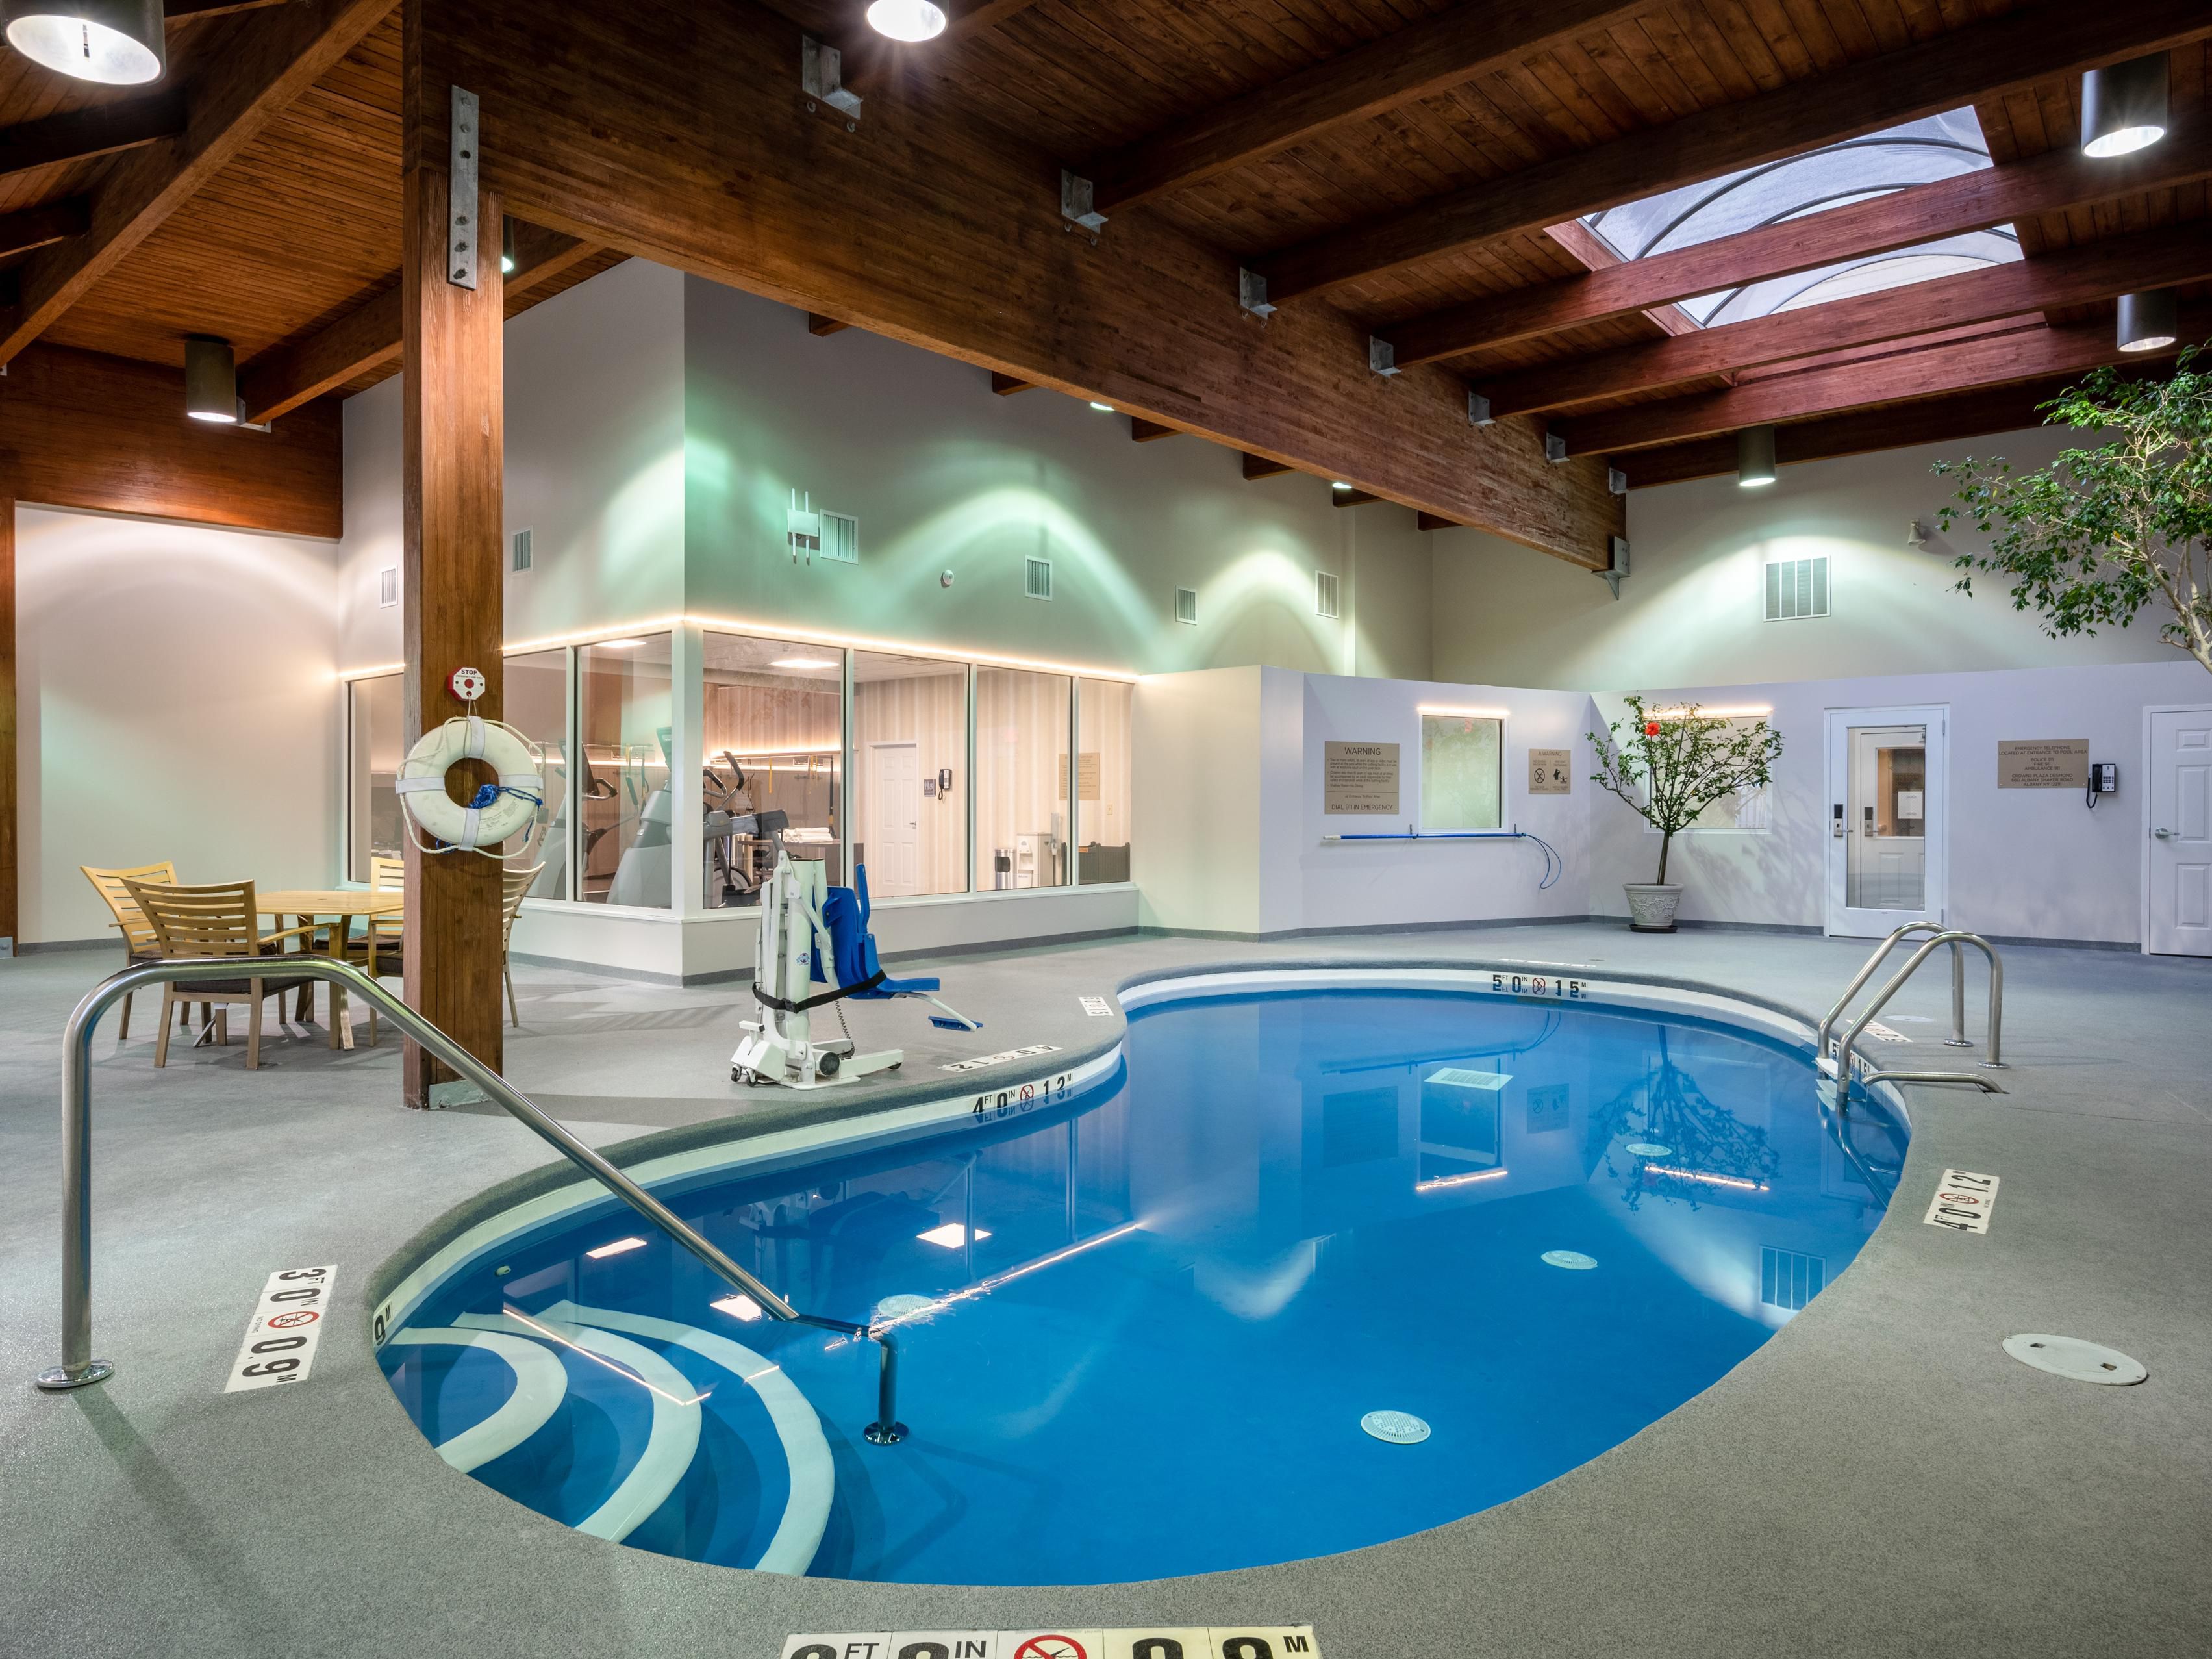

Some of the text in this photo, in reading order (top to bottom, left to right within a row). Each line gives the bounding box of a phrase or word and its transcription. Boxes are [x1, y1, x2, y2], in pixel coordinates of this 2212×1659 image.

[1344, 747, 1381, 755] WARNING
[973, 1097, 984, 1113] 4
[985, 1095, 992, 1104] FT
[1009, 1089, 1015, 1099] IN
[1067, 1073, 1072, 1082] M
[278, 1269, 327, 1280] 3
[386, 1304, 391, 1322] M
[845, 1643, 880, 1659] FT
[955, 1640, 987, 1658] IN
[1283, 1636, 1310, 1653] M
